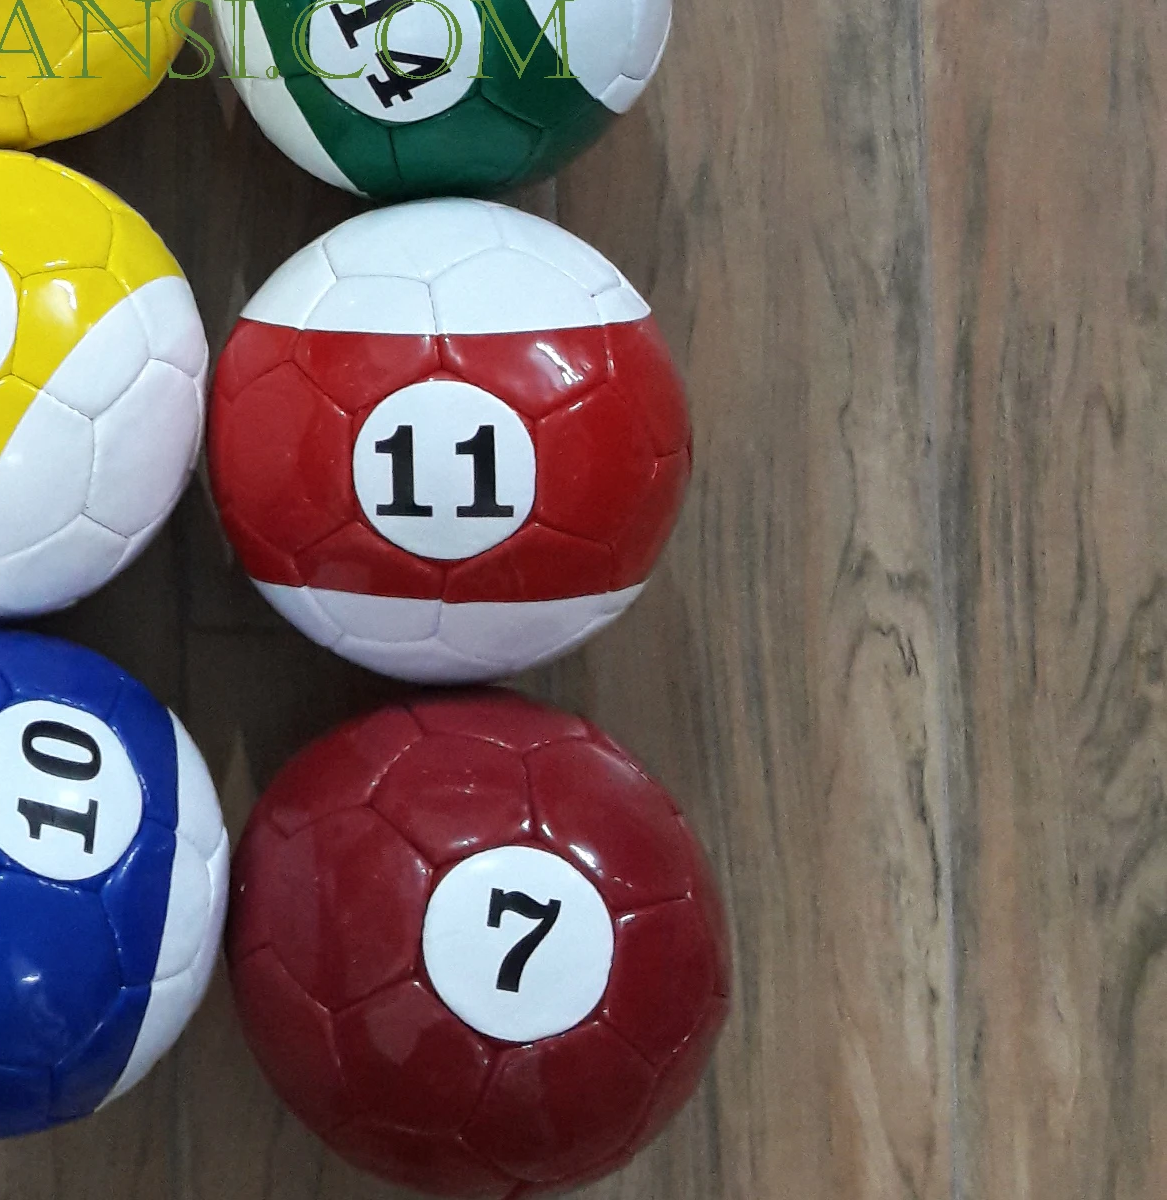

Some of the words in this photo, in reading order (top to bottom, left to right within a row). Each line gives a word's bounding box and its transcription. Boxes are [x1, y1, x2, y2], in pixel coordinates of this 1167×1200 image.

[375, 425, 513, 518] 11
[18, 721, 102, 855] 10
[487, 888, 562, 993] 7
